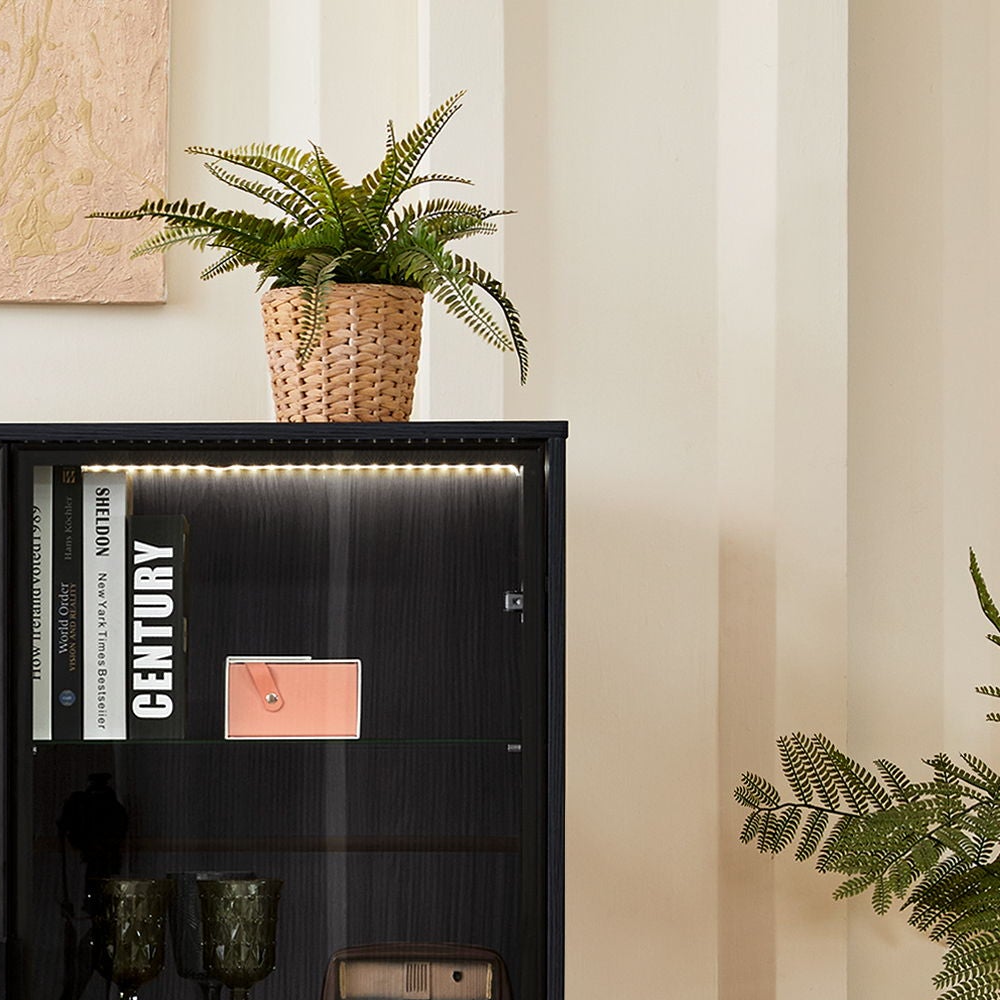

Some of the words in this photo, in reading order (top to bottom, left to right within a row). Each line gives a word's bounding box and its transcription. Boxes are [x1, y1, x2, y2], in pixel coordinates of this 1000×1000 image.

[95, 487, 111, 557] SHELDON
[64, 536, 73, 560] Hans
[58, 582, 69, 616] Order
[69, 583, 77, 619] REALITY
[97, 572, 108, 599] New
[58, 620, 70, 654] World
[69, 621, 77, 640] AND
[132, 540, 174, 719] CENTURY
[69, 643, 77, 672] VISION
[97, 631, 108, 666] Times
